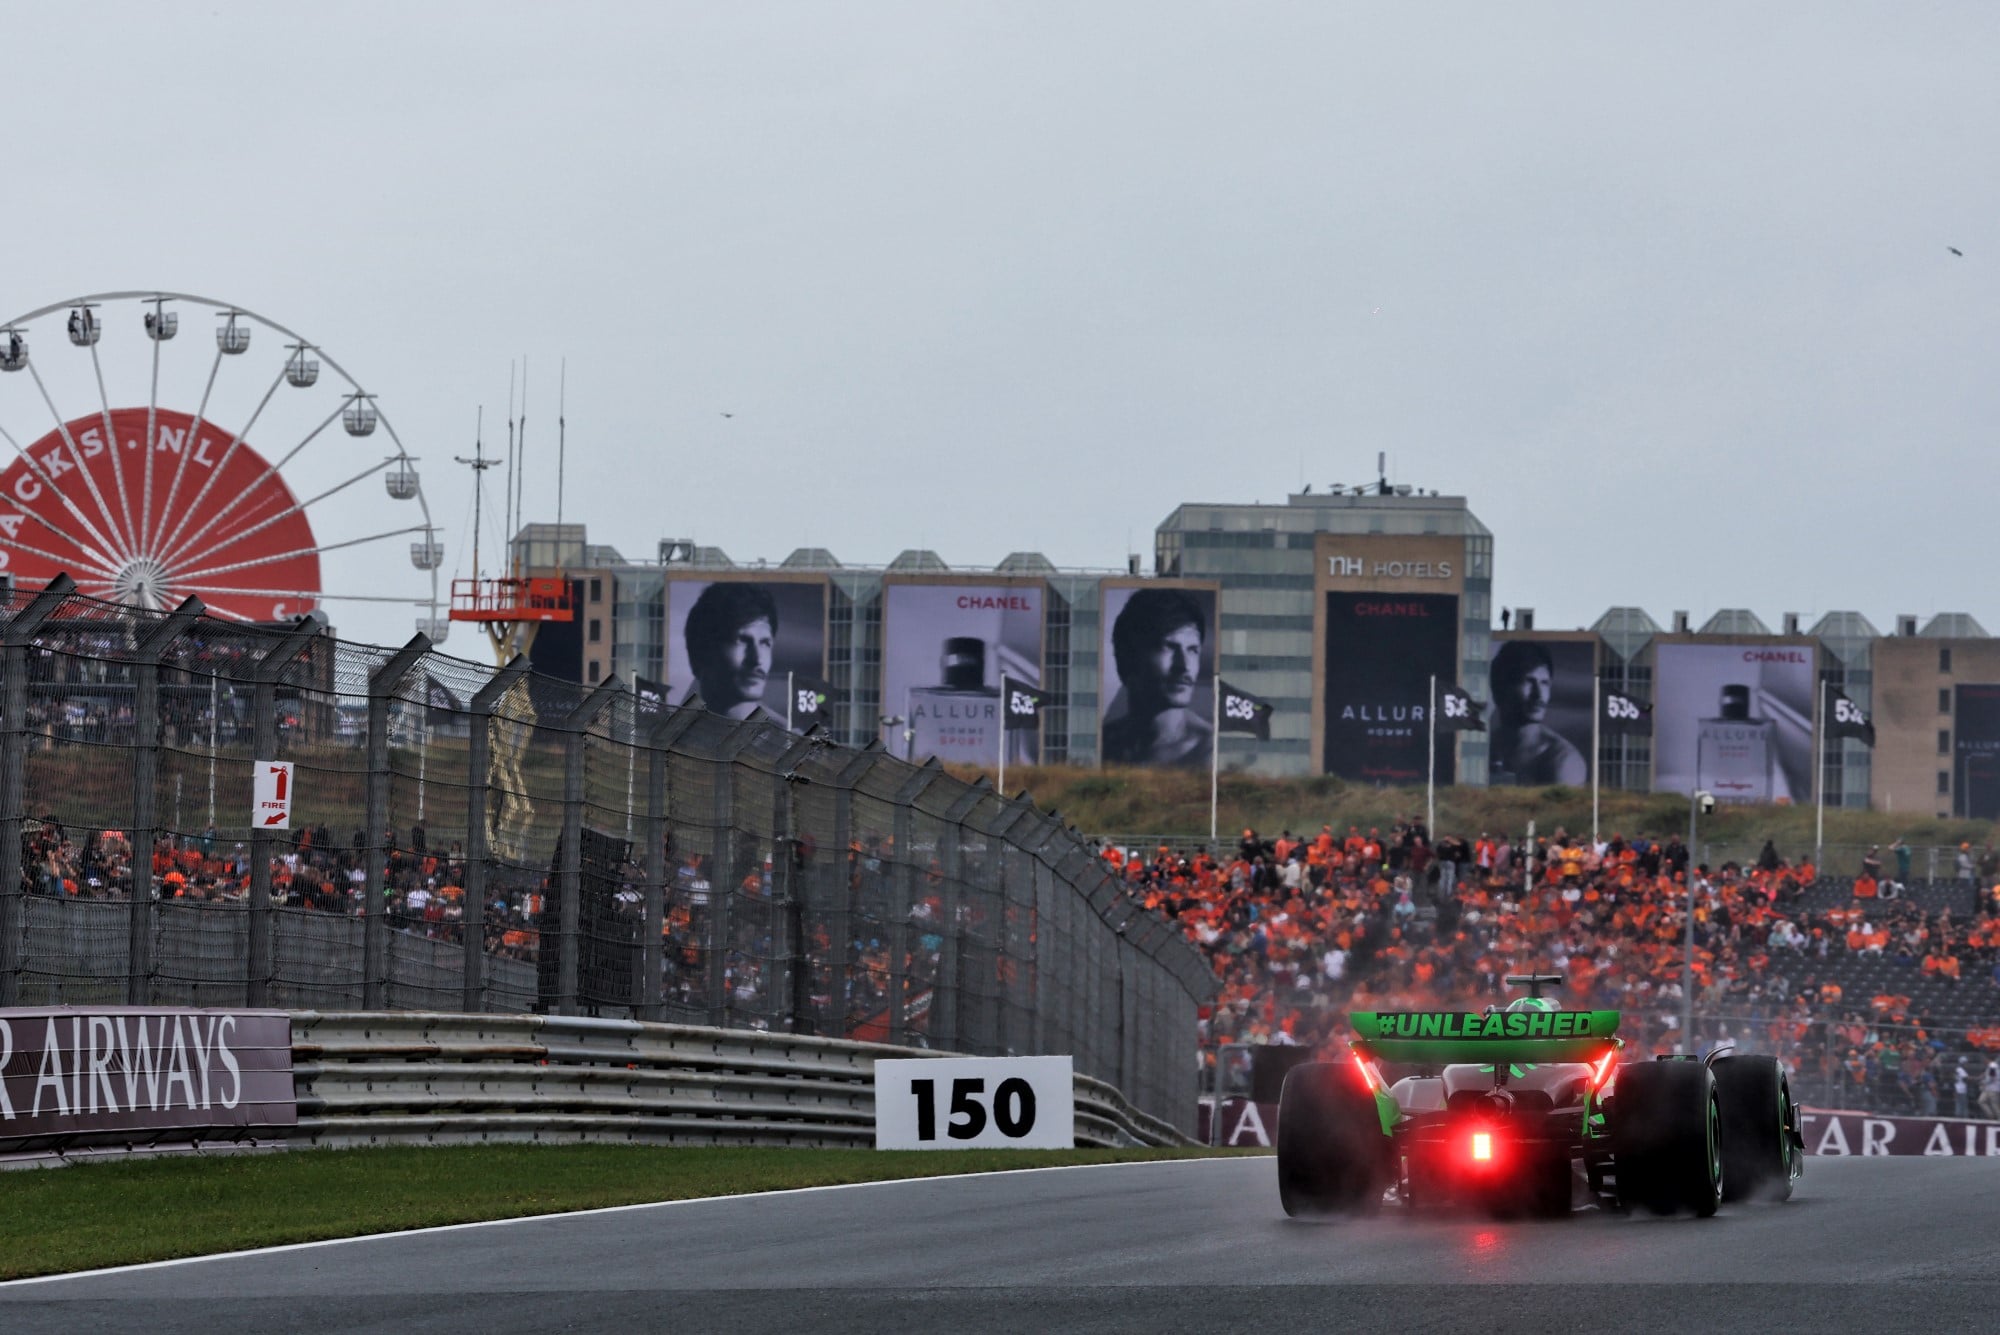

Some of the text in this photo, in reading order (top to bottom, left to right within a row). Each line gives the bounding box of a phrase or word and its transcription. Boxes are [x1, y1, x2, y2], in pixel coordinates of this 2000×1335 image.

[1373, 561, 1452, 579] HOTELS
[957, 596, 1032, 611] CHANEL
[1354, 602, 1430, 616] CHANEL
[1743, 651, 1806, 664] CHANEL
[914, 704, 996, 718] ALLUR
[1341, 705, 1425, 720] ALLUR
[261, 801, 287, 810] FIRE
[1378, 1012, 1593, 1039] #UNLEASHED
[32, 1015, 241, 1118] AIRWAYS
[911, 1077, 1036, 1141] 150
